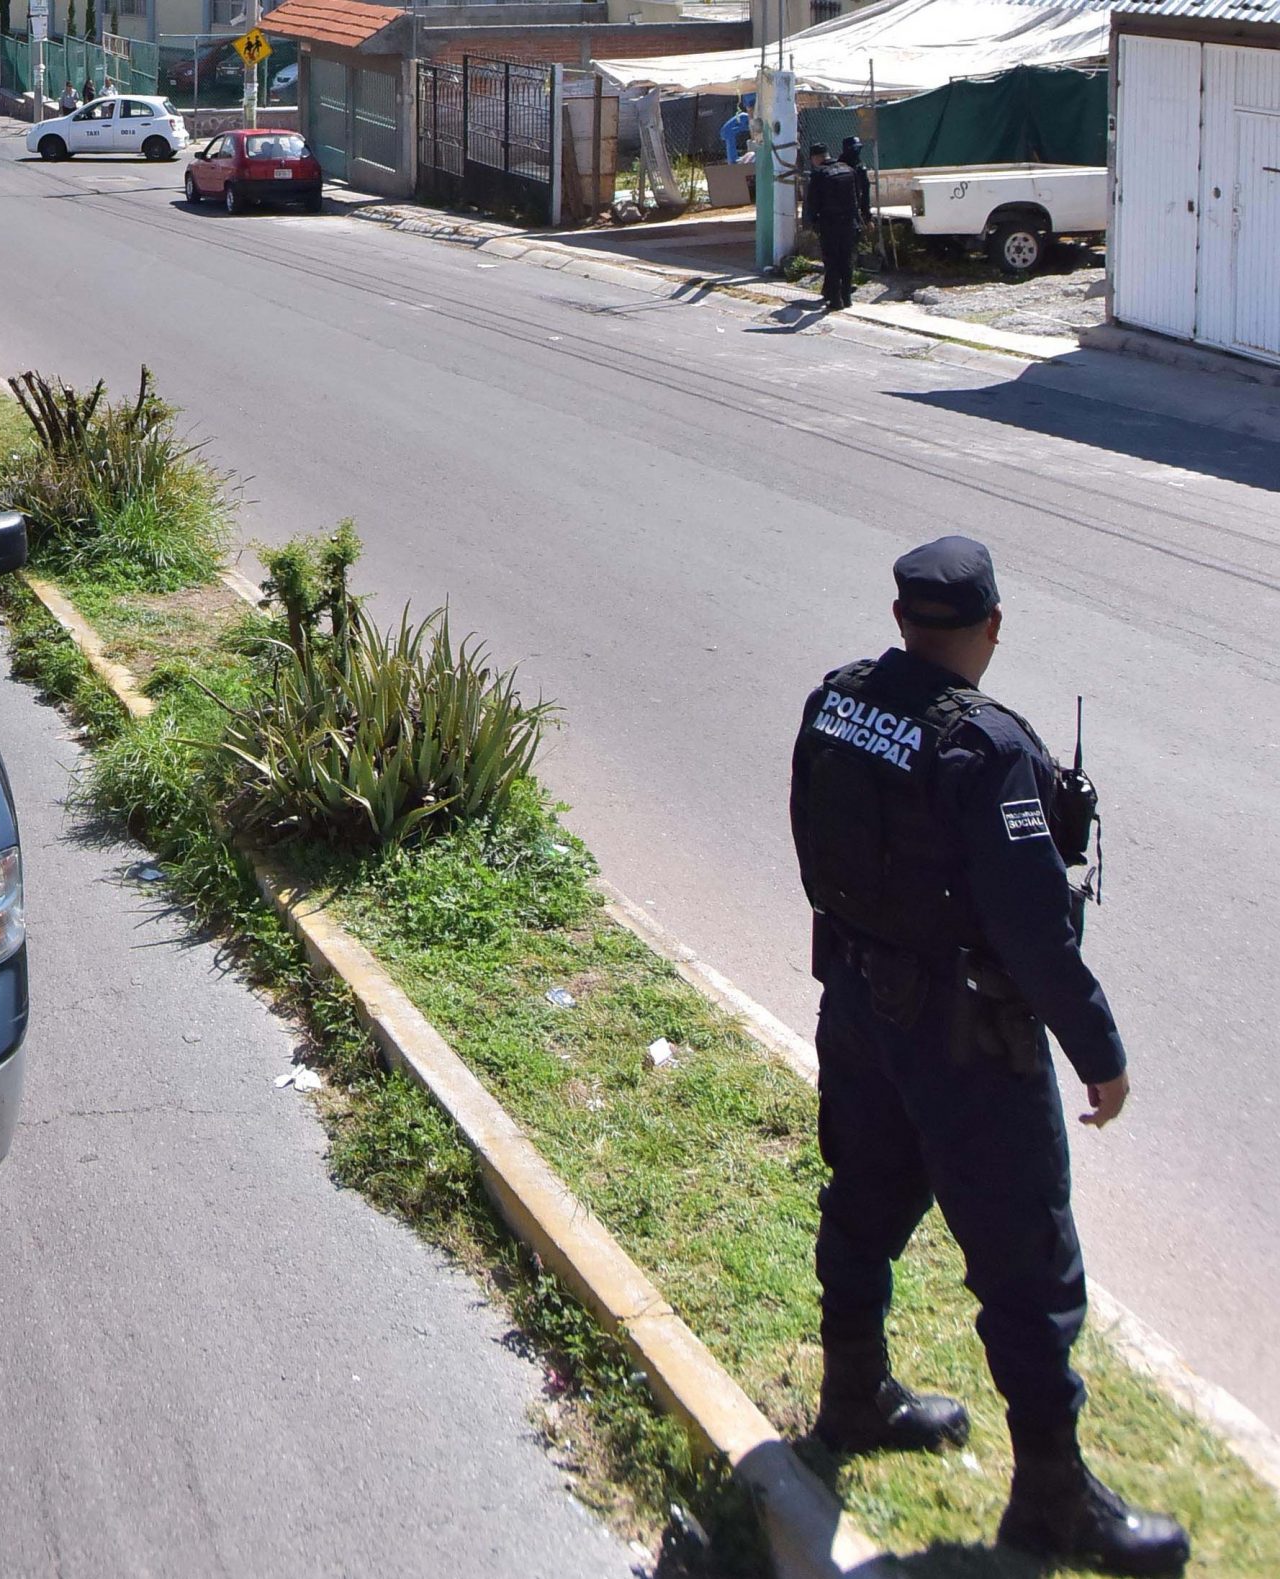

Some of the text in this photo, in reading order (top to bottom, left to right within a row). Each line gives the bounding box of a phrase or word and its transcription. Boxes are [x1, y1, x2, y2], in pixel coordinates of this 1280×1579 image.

[812, 711, 912, 773] MUNICIPAL
[822, 690, 922, 751] POLICÍA
[1009, 817, 1044, 829] SOCIAL
